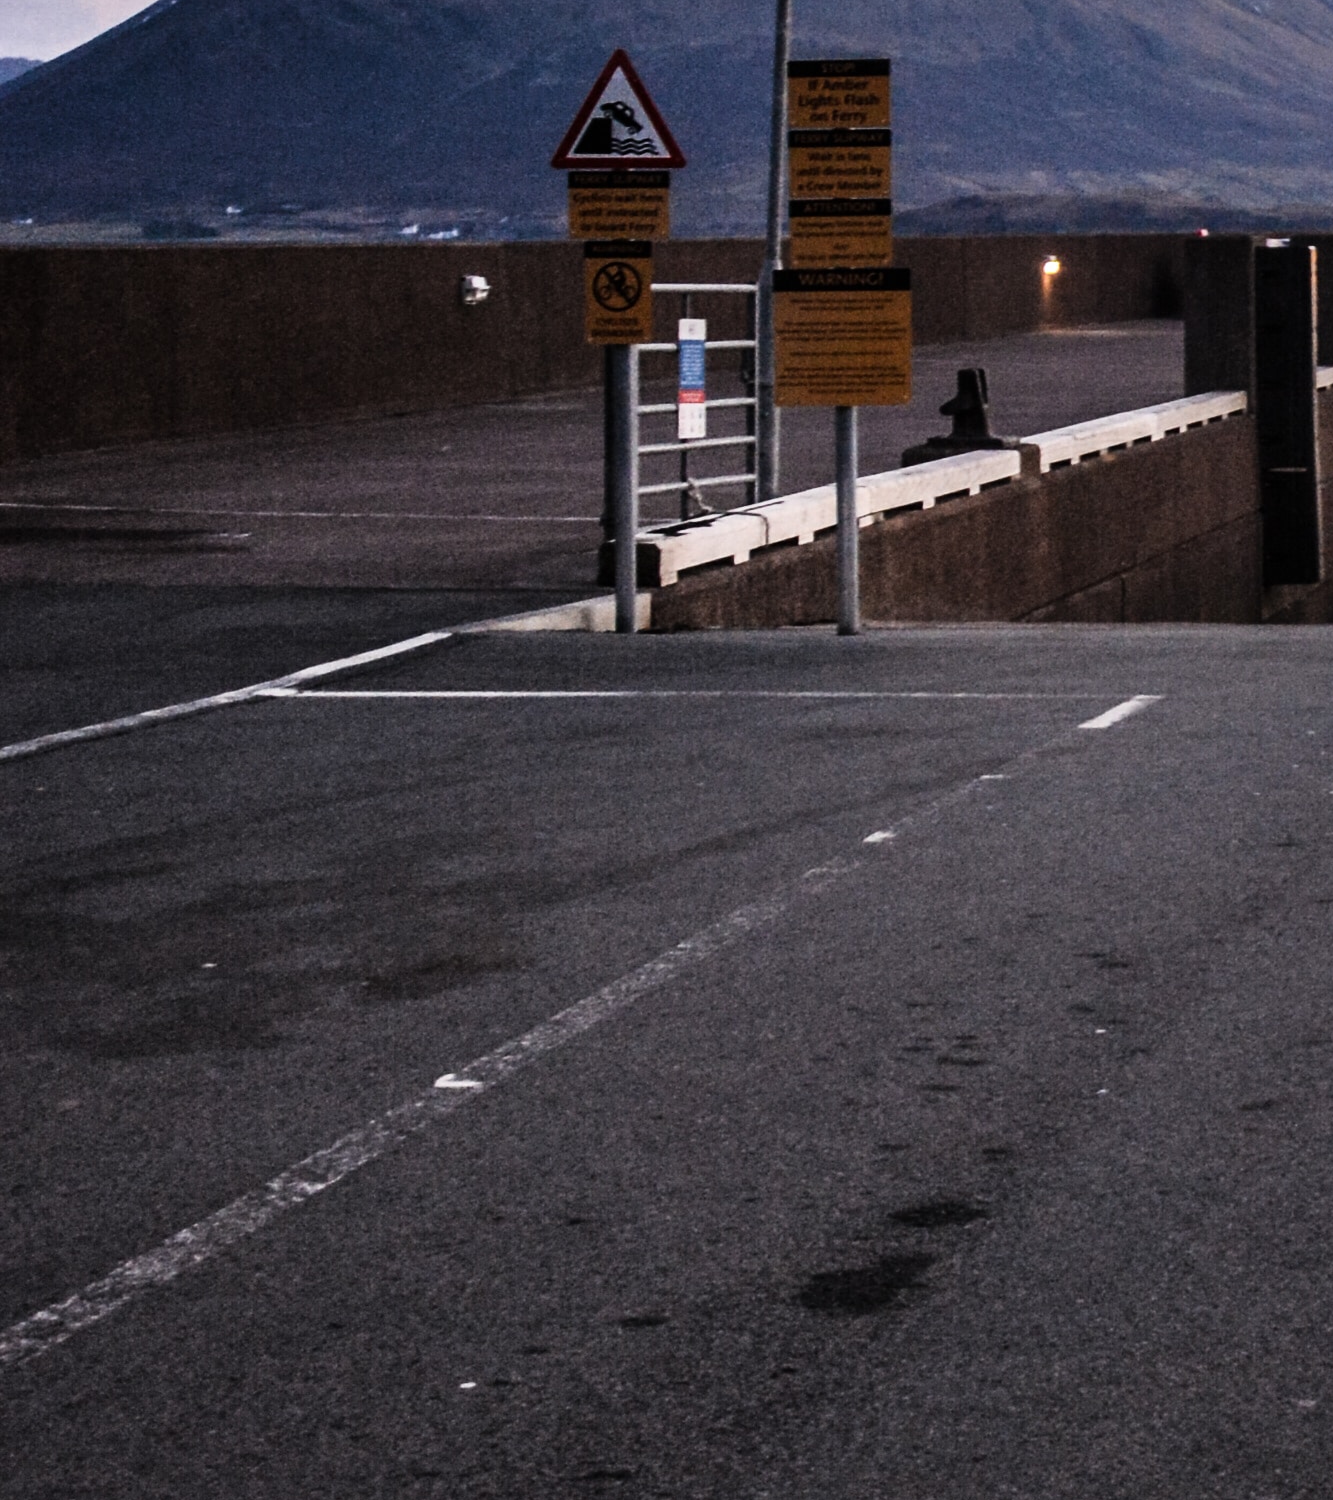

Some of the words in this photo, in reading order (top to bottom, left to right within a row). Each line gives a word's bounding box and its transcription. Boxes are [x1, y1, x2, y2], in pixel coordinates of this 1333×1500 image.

[823, 79, 868, 90] Amber
[798, 94, 840, 109] Lights
[832, 110, 867, 123] Ferry
[797, 272, 885, 286] WARNING!
